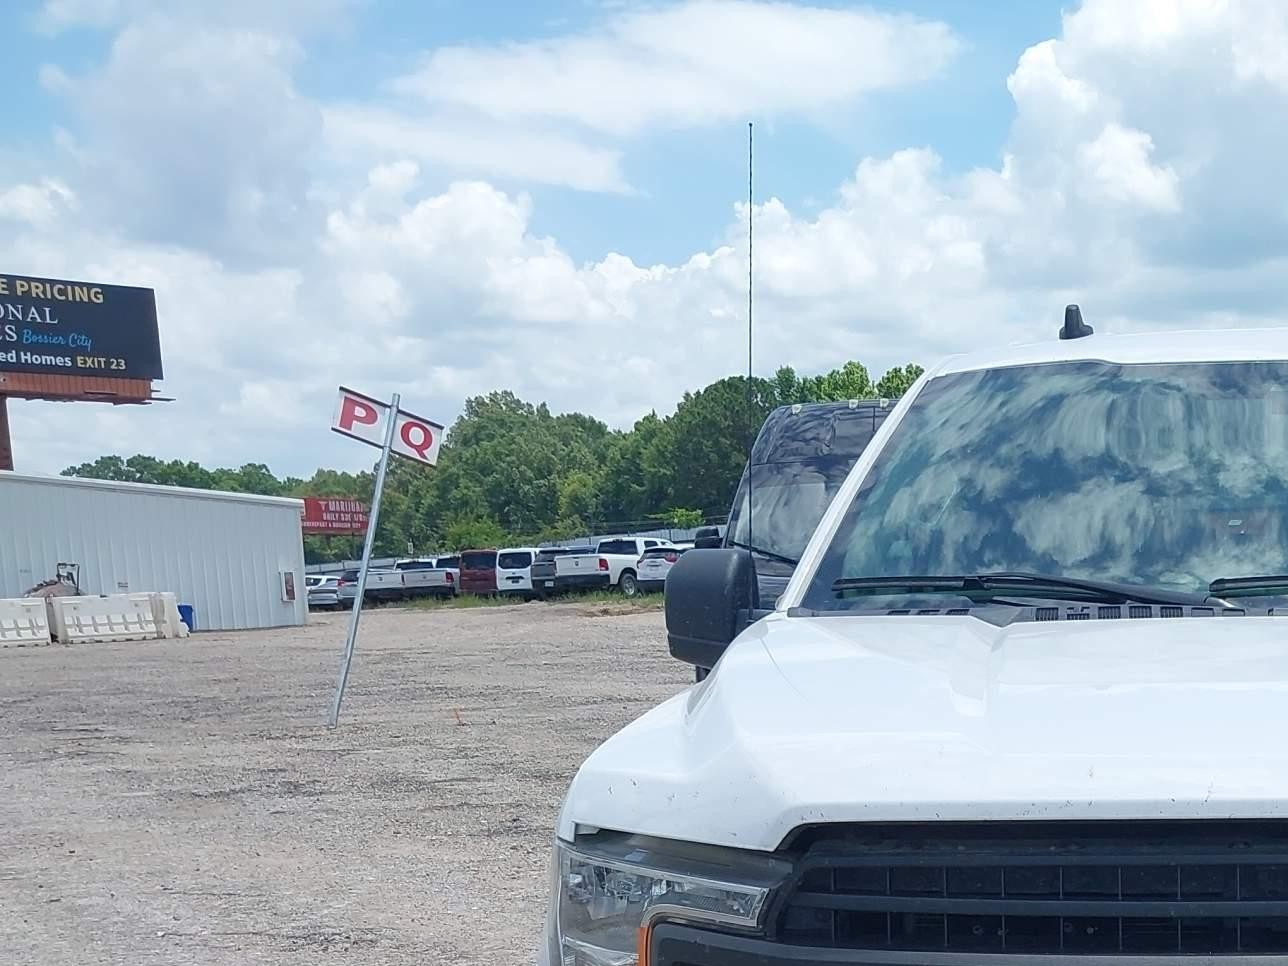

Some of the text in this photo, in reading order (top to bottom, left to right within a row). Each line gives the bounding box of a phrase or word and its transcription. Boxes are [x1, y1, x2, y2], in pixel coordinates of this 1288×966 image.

[16, 280, 104, 303] PRICING
[0, 304, 58, 324] NAL
[0, 325, 92, 352] S Bossier City
[21, 351, 72, 367] Homes
[76, 356, 106, 369] EXIT
[110, 358, 126, 370] 23
[339, 396, 433, 460] P Q
